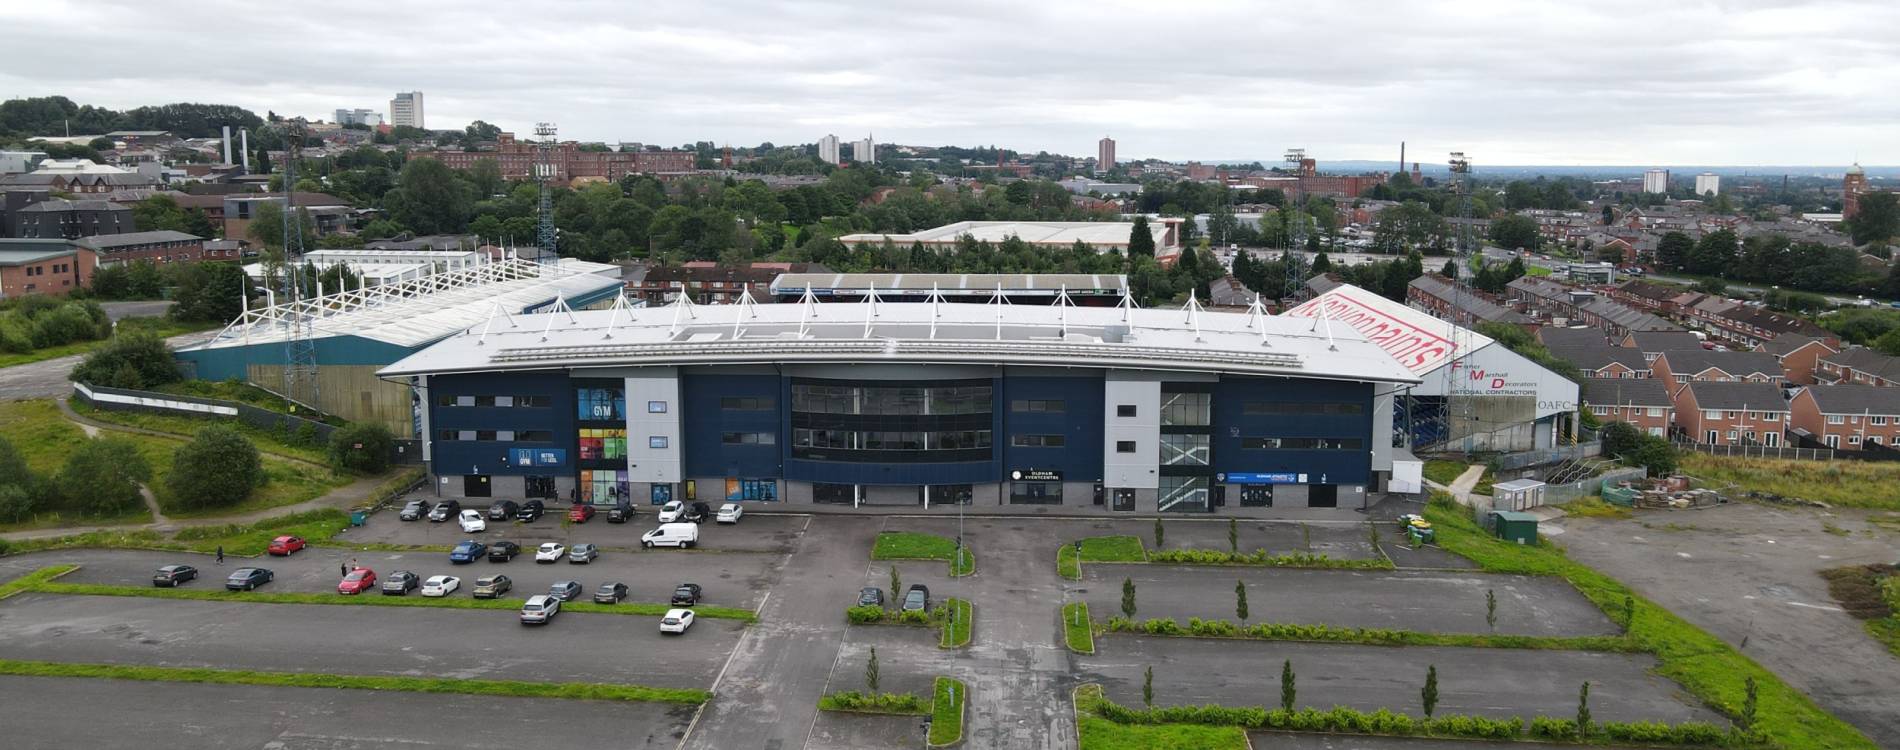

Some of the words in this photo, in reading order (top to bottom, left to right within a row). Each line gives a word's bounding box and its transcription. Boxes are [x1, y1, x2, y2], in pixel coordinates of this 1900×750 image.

[1470, 370, 1508, 380] Marshall
[1491, 378, 1537, 389] Decorators
[1537, 401, 1571, 410] OAFC
[593, 405, 612, 417] GYM
